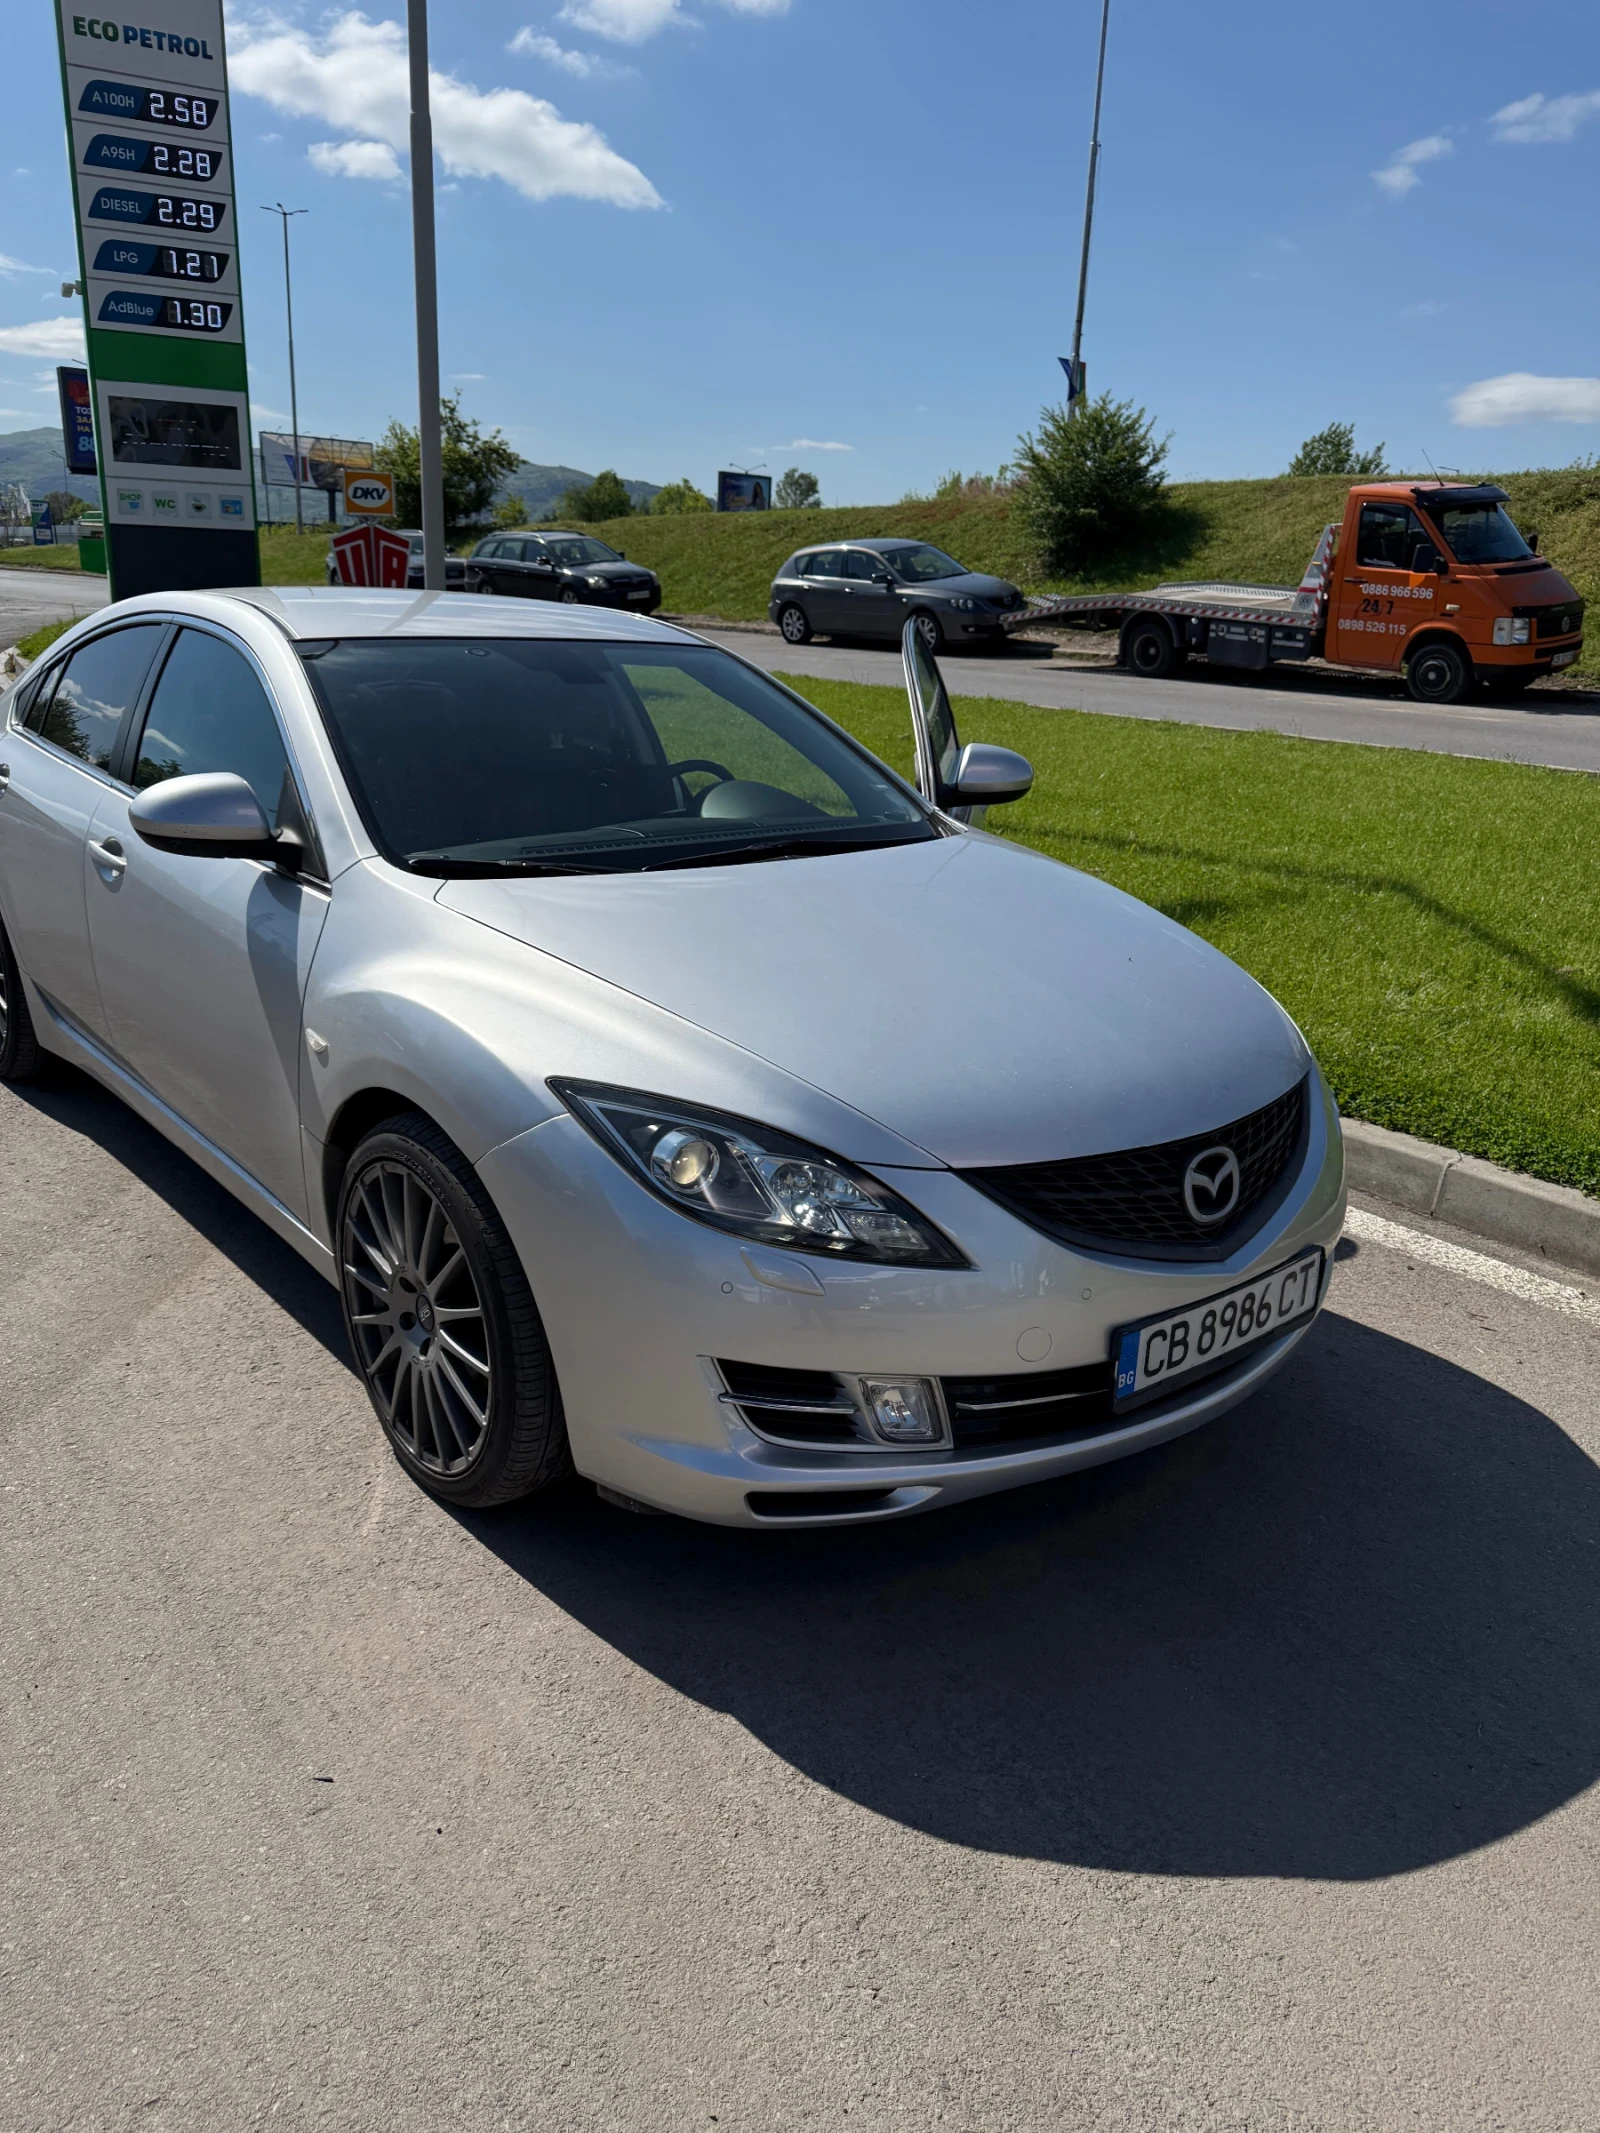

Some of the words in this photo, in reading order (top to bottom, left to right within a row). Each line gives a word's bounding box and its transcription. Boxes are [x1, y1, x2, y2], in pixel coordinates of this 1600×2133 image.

[73, 15, 119, 42] ECO
[123, 25, 213, 60] PETROL
[92, 90, 134, 108] A100H
[149, 92, 207, 126] 2.58
[101, 145, 135, 161] A95H
[154, 145, 211, 178] 2.28
[101, 197, 142, 214] DIESEL
[158, 198, 215, 229] 2.29
[113, 250, 139, 264] LPG
[168, 250, 219, 279] 1.21
[108, 301, 154, 316] AdBlue
[172, 300, 223, 329] 1.30
[120, 492, 142, 501] SHOP
[154, 498, 176, 509] WC
[352, 486, 387, 500] DKV
[1361, 583, 1389, 595] 0886
[1390, 585, 1411, 597] 966
[1412, 588, 1433, 599] 596
[1338, 619, 1364, 631] 0898
[1365, 621, 1386, 633] 526
[1388, 624, 1406, 636] 115
[1143, 1320, 1190, 1378] CB
[1197, 1282, 1272, 1356] 8986
[1277, 1260, 1316, 1317] CT
[1117, 1370, 1134, 1389] BG
